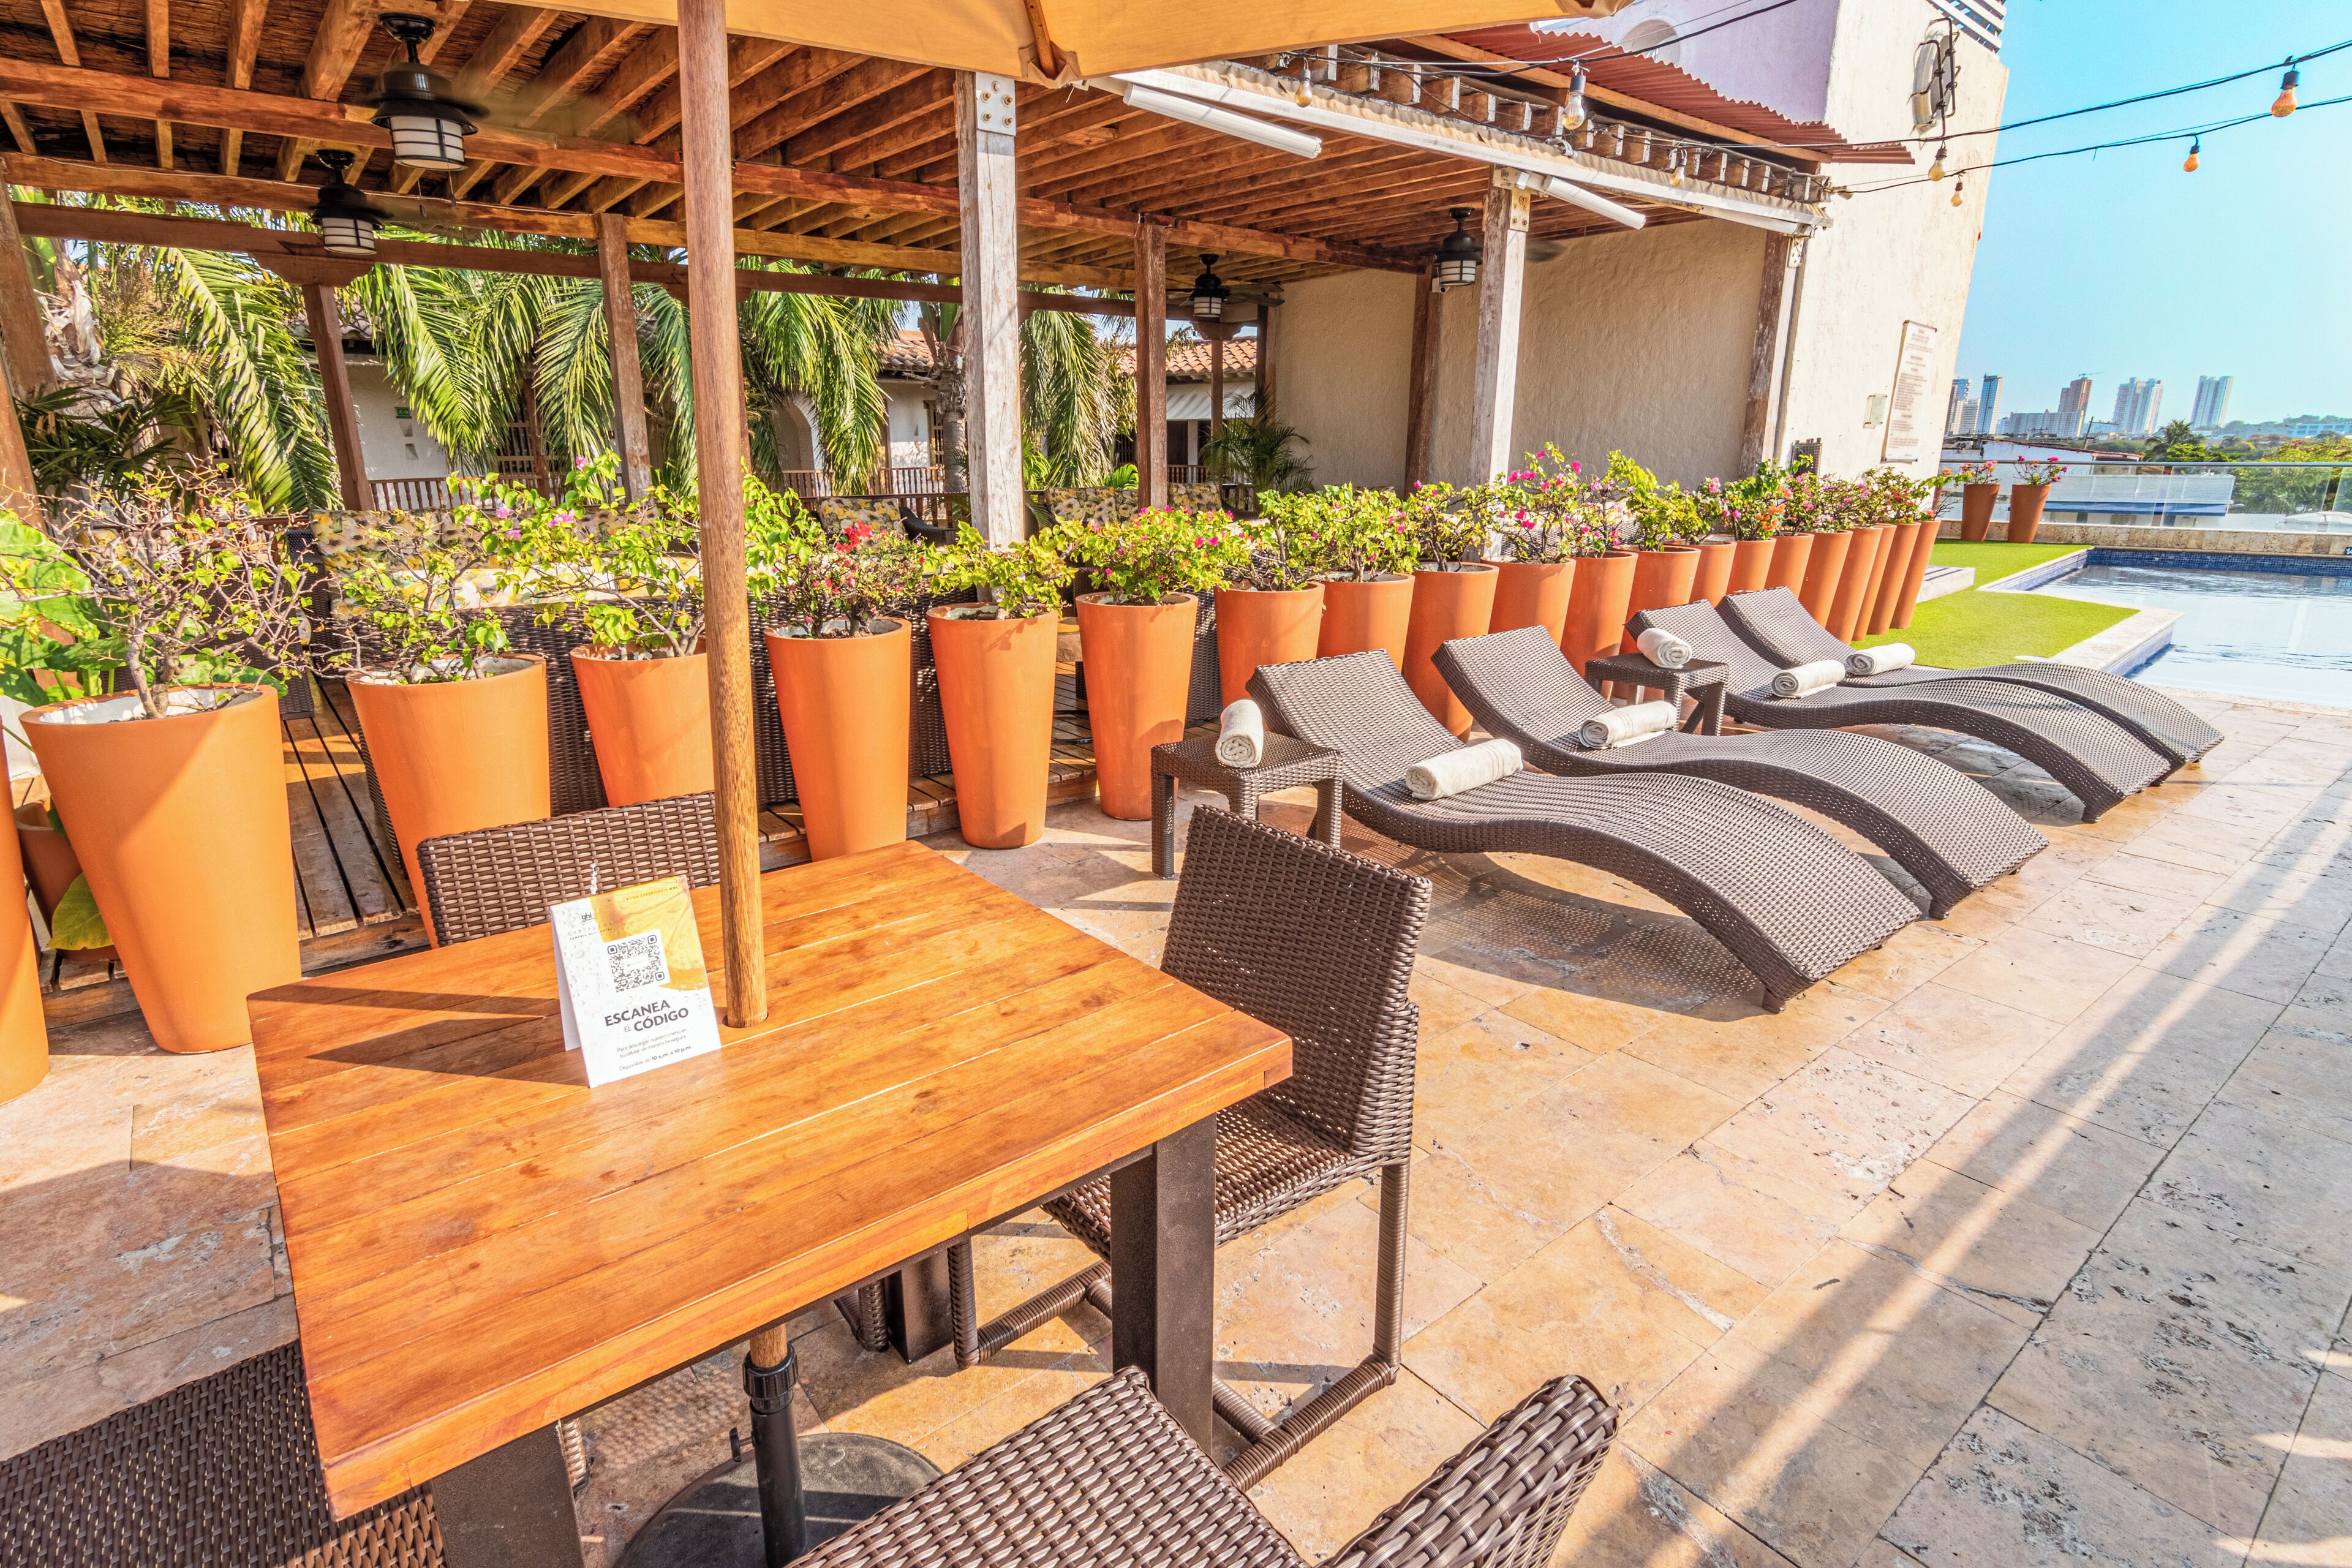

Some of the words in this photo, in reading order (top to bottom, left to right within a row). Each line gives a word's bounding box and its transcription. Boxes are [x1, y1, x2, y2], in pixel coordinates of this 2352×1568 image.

[641, 889, 668, 897] EXPERIENCIA
[581, 913, 592, 922] ghl
[605, 1000, 671, 1026] ESCANEA
[633, 1008, 689, 1031] CÓDIGO
[628, 1039, 649, 1050] descargar
[650, 1034, 668, 1042] nuestro
[619, 1060, 644, 1071] Disponible
